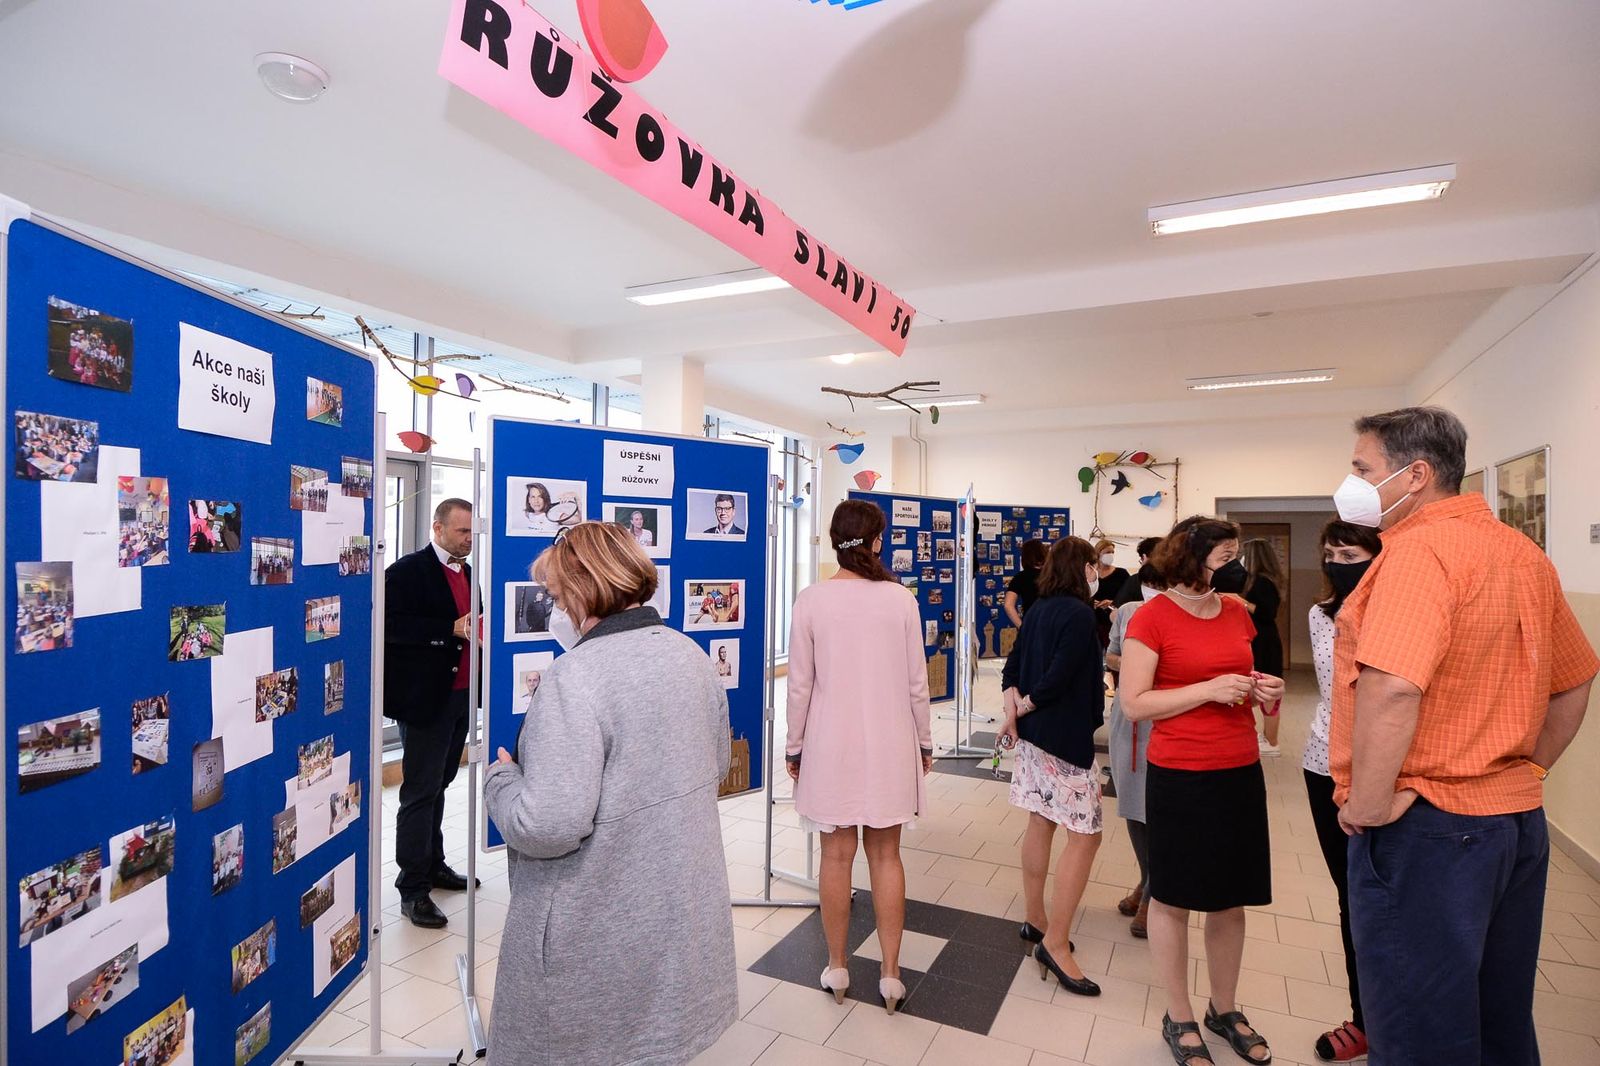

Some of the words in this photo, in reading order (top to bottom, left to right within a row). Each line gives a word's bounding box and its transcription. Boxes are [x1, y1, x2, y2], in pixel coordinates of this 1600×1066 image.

[460, 0, 766, 237] RŮŽOVKA
[793, 229, 877, 314] SLAVÍ
[890, 305, 911, 339] 50
[192, 349, 233, 377] Akce
[237, 367, 265, 386] naší
[211, 383, 251, 413] školy
[620, 449, 661, 461] ÚSPĚŠNÍ
[621, 475, 659, 484] RŮŽOVKY
